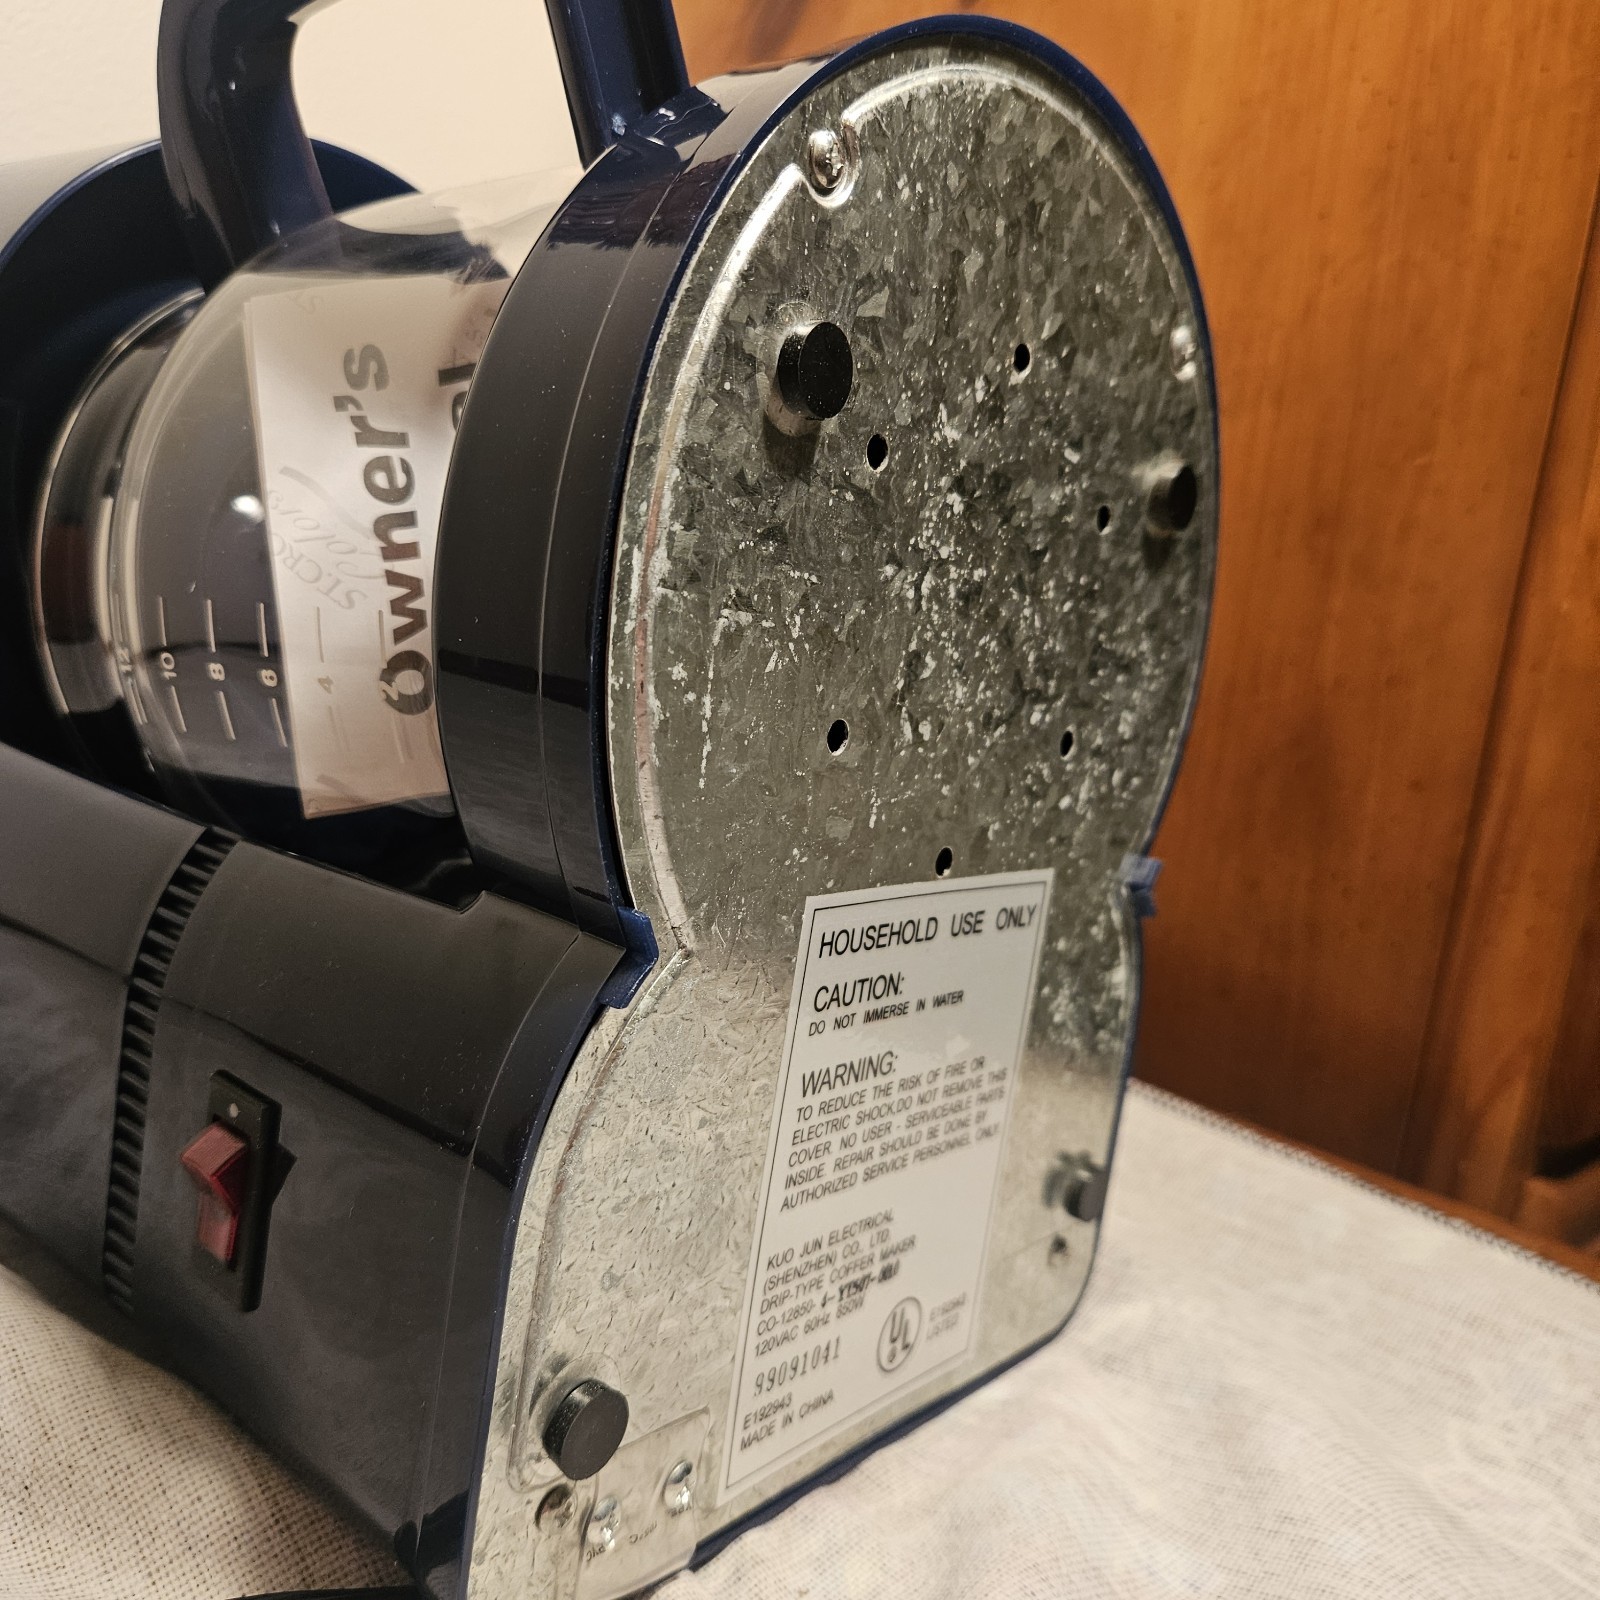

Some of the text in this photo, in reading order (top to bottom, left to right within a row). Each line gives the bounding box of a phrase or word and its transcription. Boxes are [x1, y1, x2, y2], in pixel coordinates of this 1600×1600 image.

[333, 344, 434, 716] Owner's
[161, 652, 177, 680] 10
[208, 662, 225, 682] 8
[260, 669, 278, 687] 6
[818, 903, 1037, 959] HOUSEHOLD USE ONLY
[808, 990, 964, 1037] DO NOT IMMERSE IN WATER
[813, 971, 905, 1013] CAUTION:
[796, 1055, 985, 1123] TO REDUCE THE RISK OF FIRE OR
[801, 1050, 899, 1098] WARNING:
[791, 1114, 851, 1146] ELECTRIC
[916, 1087, 939, 1108] NOT
[942, 1076, 983, 1099] REMOVE
[840, 1132, 857, 1150] NO
[862, 1121, 892, 1144] USER
[905, 1096, 972, 1129] SERVICEABLE
[833, 1146, 875, 1173] REPAIR
[879, 1129, 923, 1157] SHOULD
[926, 1123, 940, 1141] BE
[944, 1113, 972, 1134] DONE
[780, 1171, 858, 1213] AUTHORIZED
[863, 1153, 909, 1183] SERVICE
[912, 1132, 972, 1164] PERSONNEL
[766, 1208, 894, 1272] KUO JUN ELECTRICAL
[760, 1271, 825, 1316] DRIP-TYPE
[879, 1234, 917, 1262] MAKER
[763, 1249, 838, 1296] (SHENZHEN)
[754, 1335, 842, 1398] 99091041
[755, 1324, 799, 1358] 120VAC
[740, 1389, 834, 1451] MADE IN CHINA
